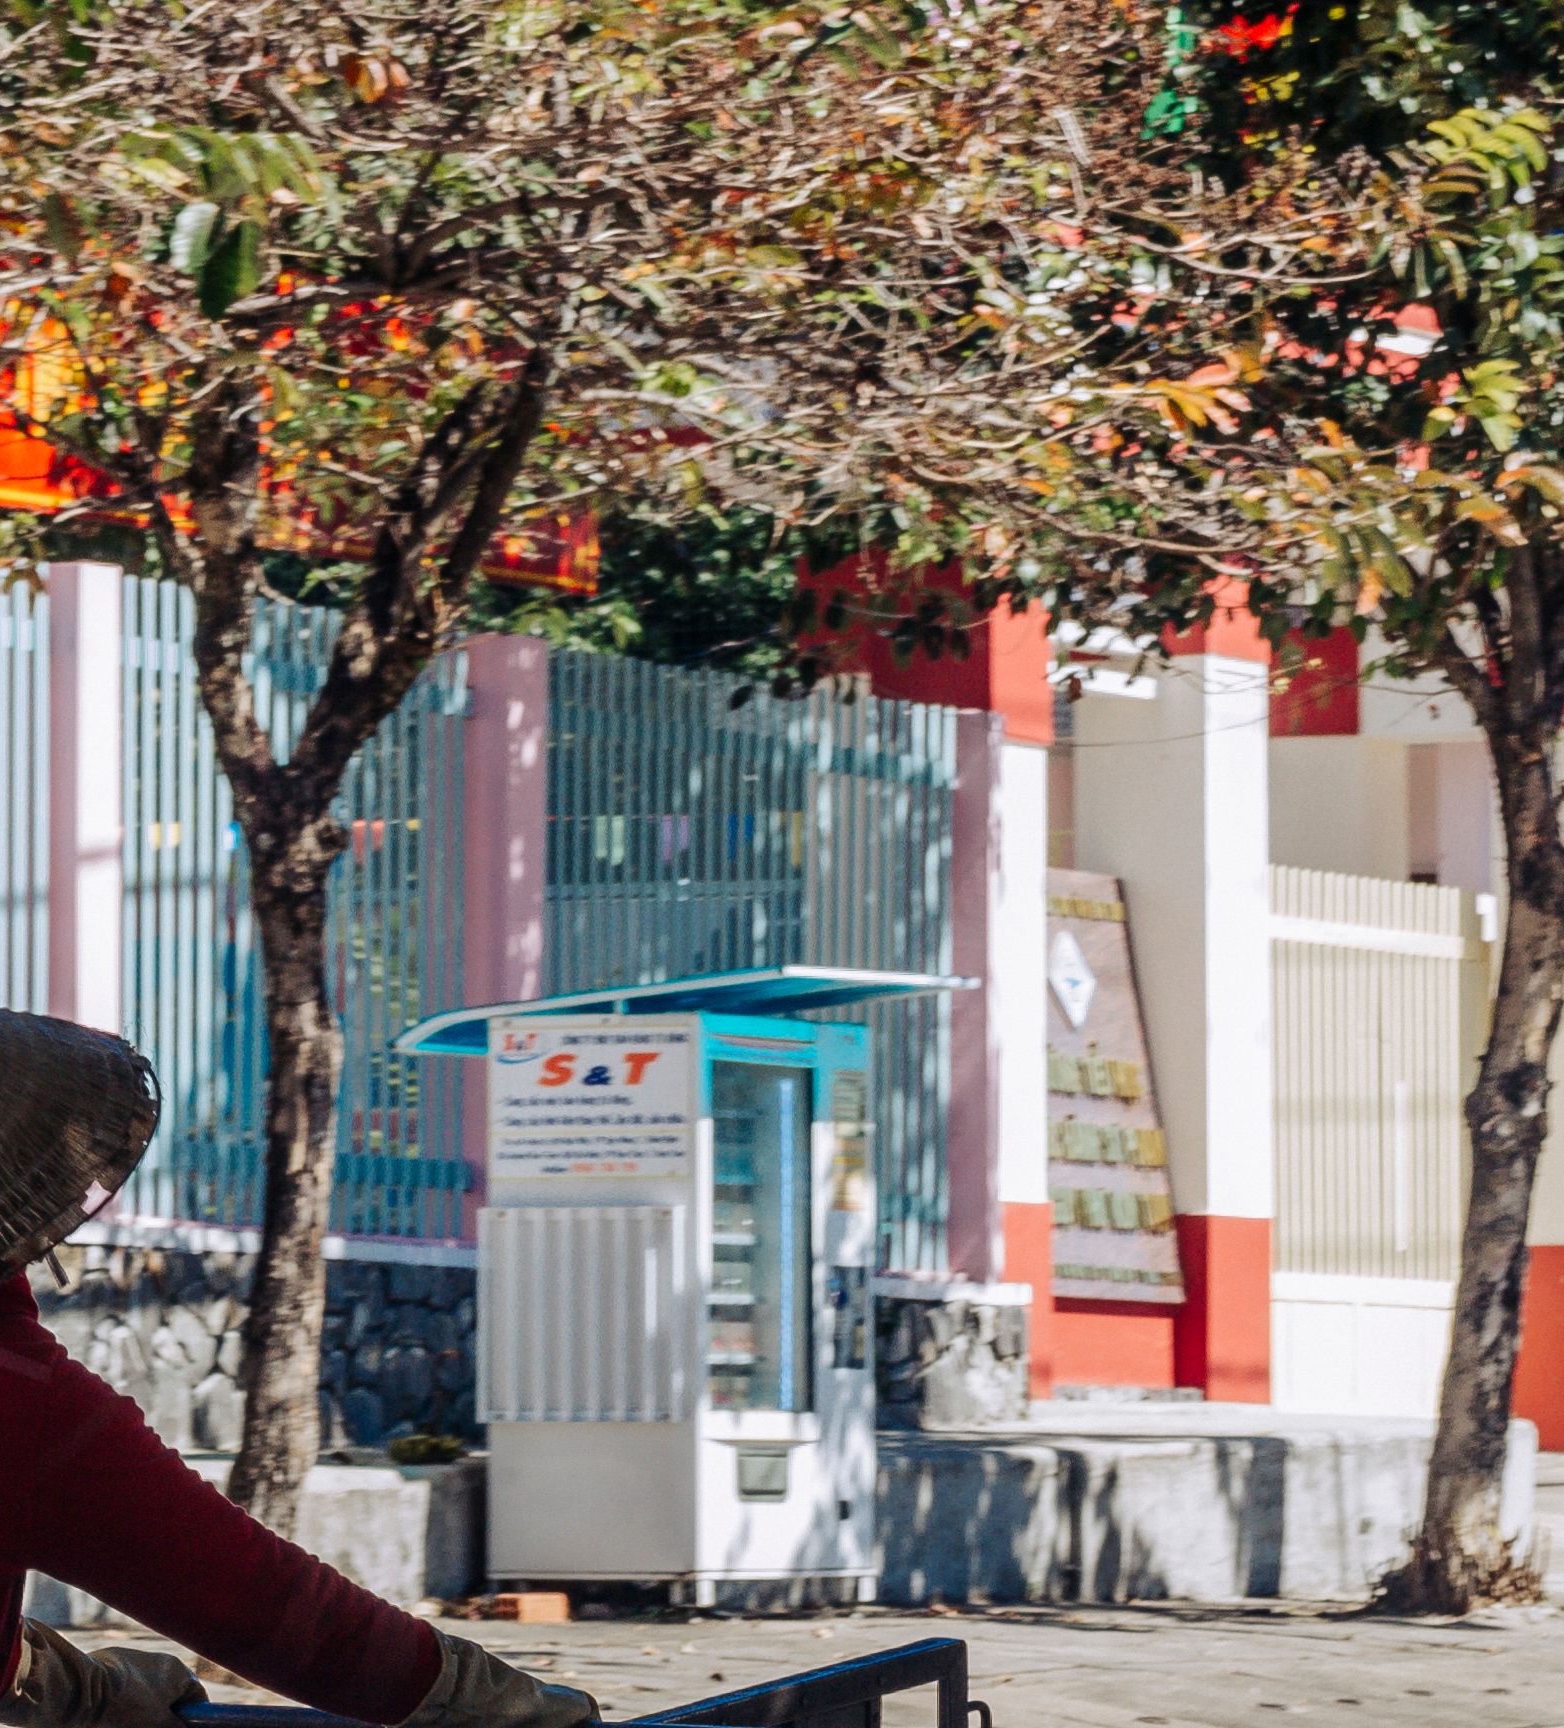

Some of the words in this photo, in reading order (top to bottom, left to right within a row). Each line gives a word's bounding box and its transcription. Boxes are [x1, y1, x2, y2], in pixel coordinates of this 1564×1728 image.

[539, 1053, 576, 1086] S
[582, 1065, 612, 1086] &
[624, 1052, 660, 1085] T
